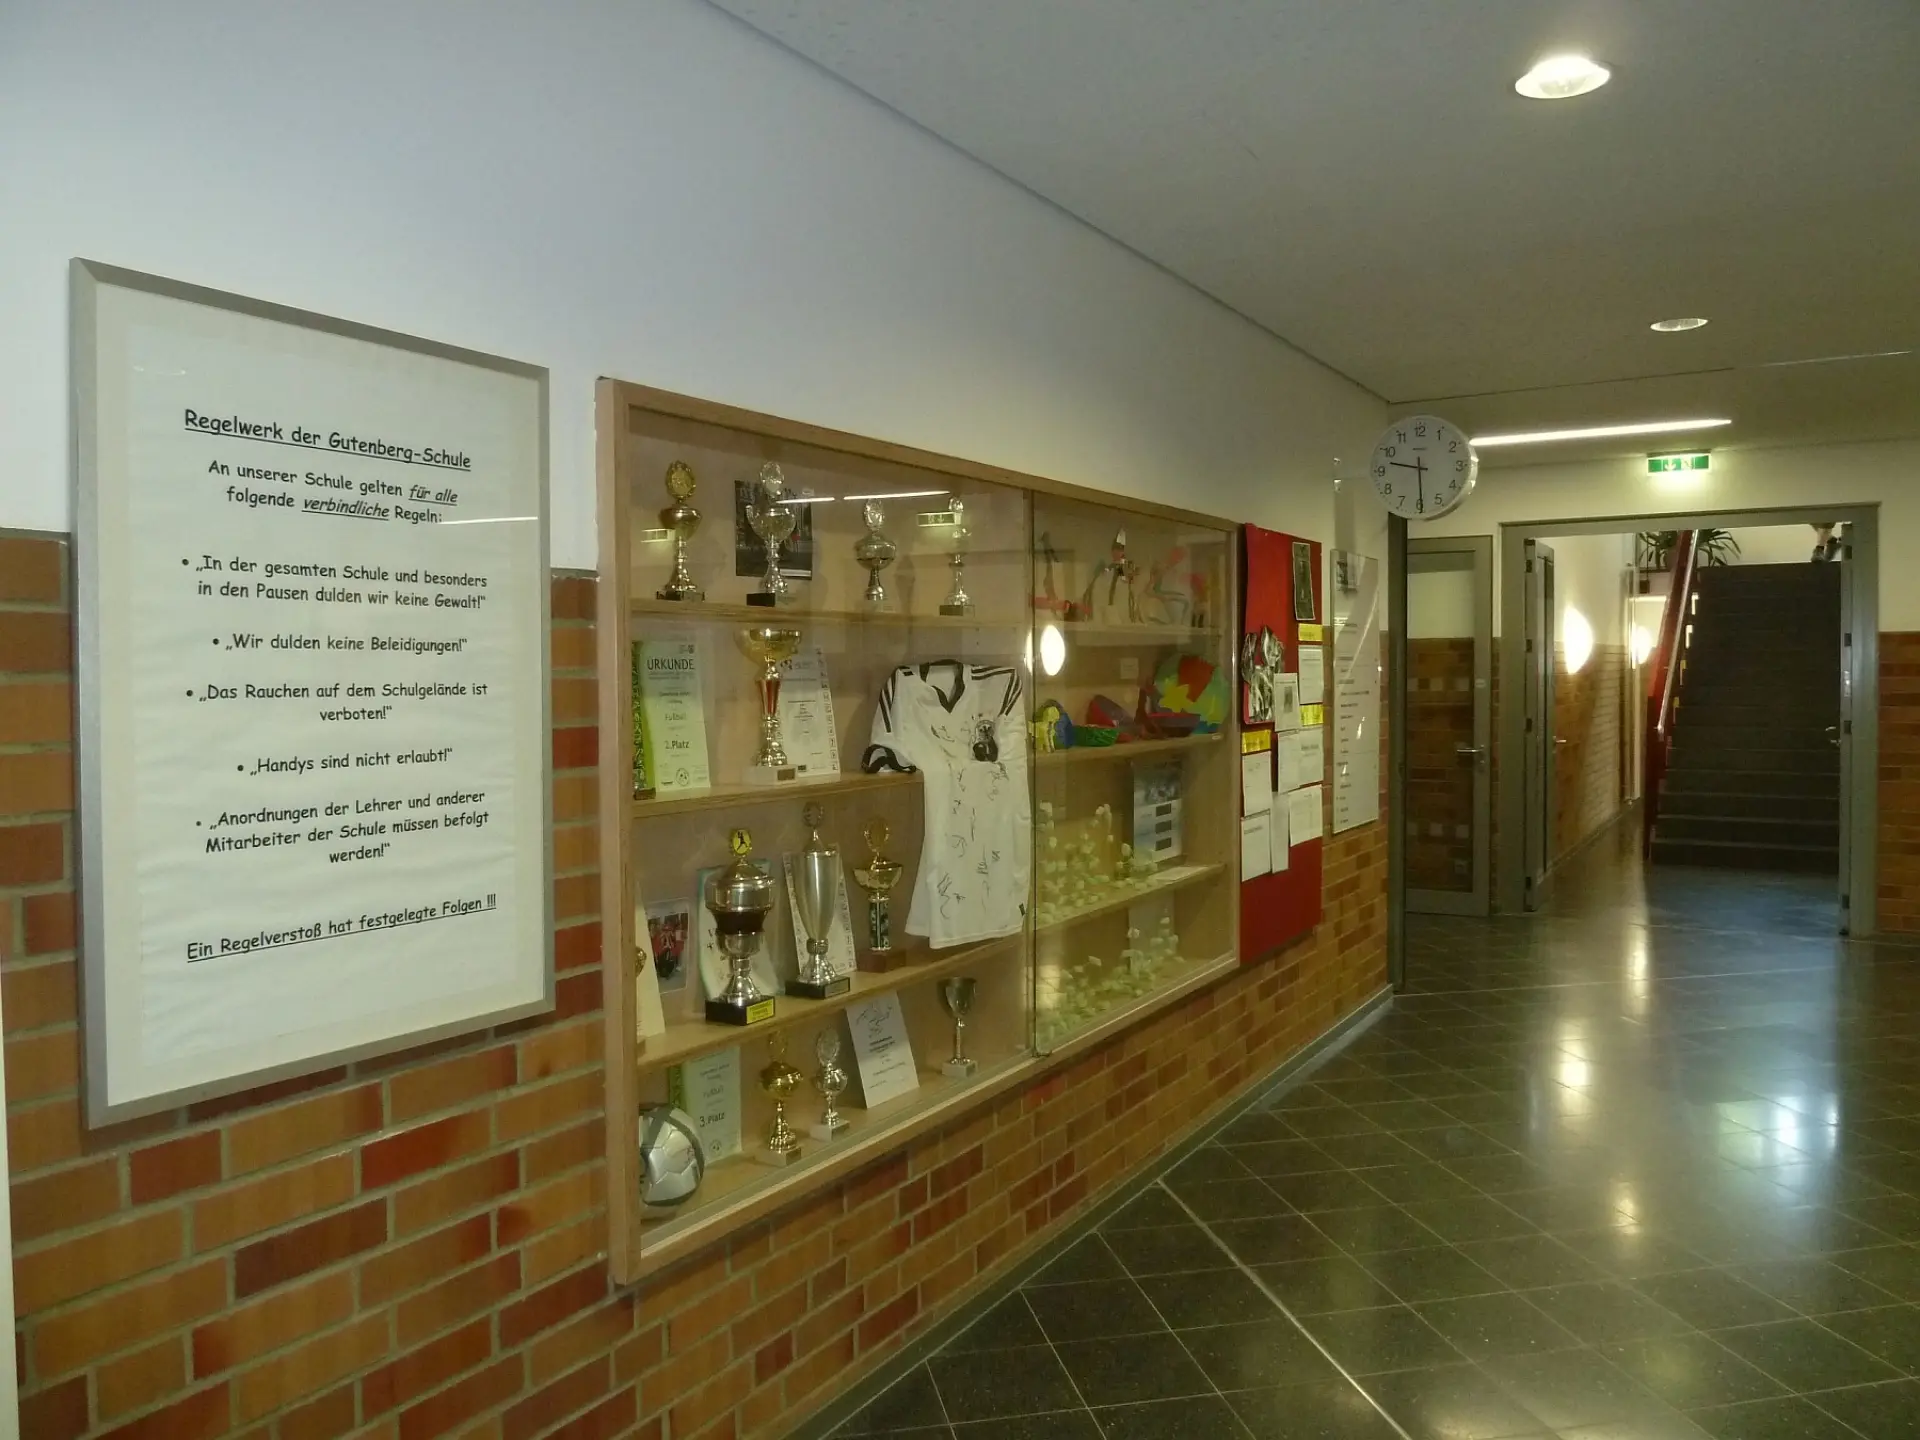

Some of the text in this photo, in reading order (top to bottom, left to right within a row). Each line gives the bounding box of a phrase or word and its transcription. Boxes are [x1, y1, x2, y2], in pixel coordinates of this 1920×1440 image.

[1415, 425, 1425, 436] 12
[1437, 430, 1441, 440] 1
[184, 409, 471, 467] Regelwerk der Gutenberg-Schule
[1398, 433, 1406, 443] 11
[1385, 447, 1395, 457] 10
[1449, 442, 1456, 453] 2
[1378, 466, 1385, 476] 9
[1456, 461, 1463, 471] 3
[209, 460, 457, 503] An unserer Schule gelten für alle
[1449, 480, 1456, 489] 4
[1385, 484, 1392, 494] 8
[227, 486, 442, 524] folgende verbindliche Regeln:
[1399, 496, 1405, 507] 7
[1416, 499, 1423, 510] 6
[1435, 494, 1442, 504] 5
[196, 556, 487, 587] „In der gesamten Schule und besonders
[198, 582, 485, 608] in den Pausen dulden wir keine Gewalt!“
[226, 634, 467, 655] „Wir dulden keine Beleidigungen!“
[647, 659, 695, 670] URKUNDE
[199, 682, 487, 701] „Das Rauchen auf dem Schulgelände ist
[320, 706, 392, 721] verboten!“
[665, 740, 689, 749] 2.Platz
[250, 748, 452, 775] „Handys sind nicht erlaubt!“
[210, 790, 485, 829] „Anordnungen der Lehrer und anderer
[205, 812, 489, 853] Mitarbeiter der Schule müssen befolgt
[330, 844, 390, 863] werden!“
[188, 941, 213, 960] Ein
[220, 923, 321, 953] Regelverstoß
[329, 919, 352, 934] hat
[359, 905, 436, 929] festgelegte
[442, 898, 482, 916] Folgen
[700, 1112, 725, 1127] 3.Platz
